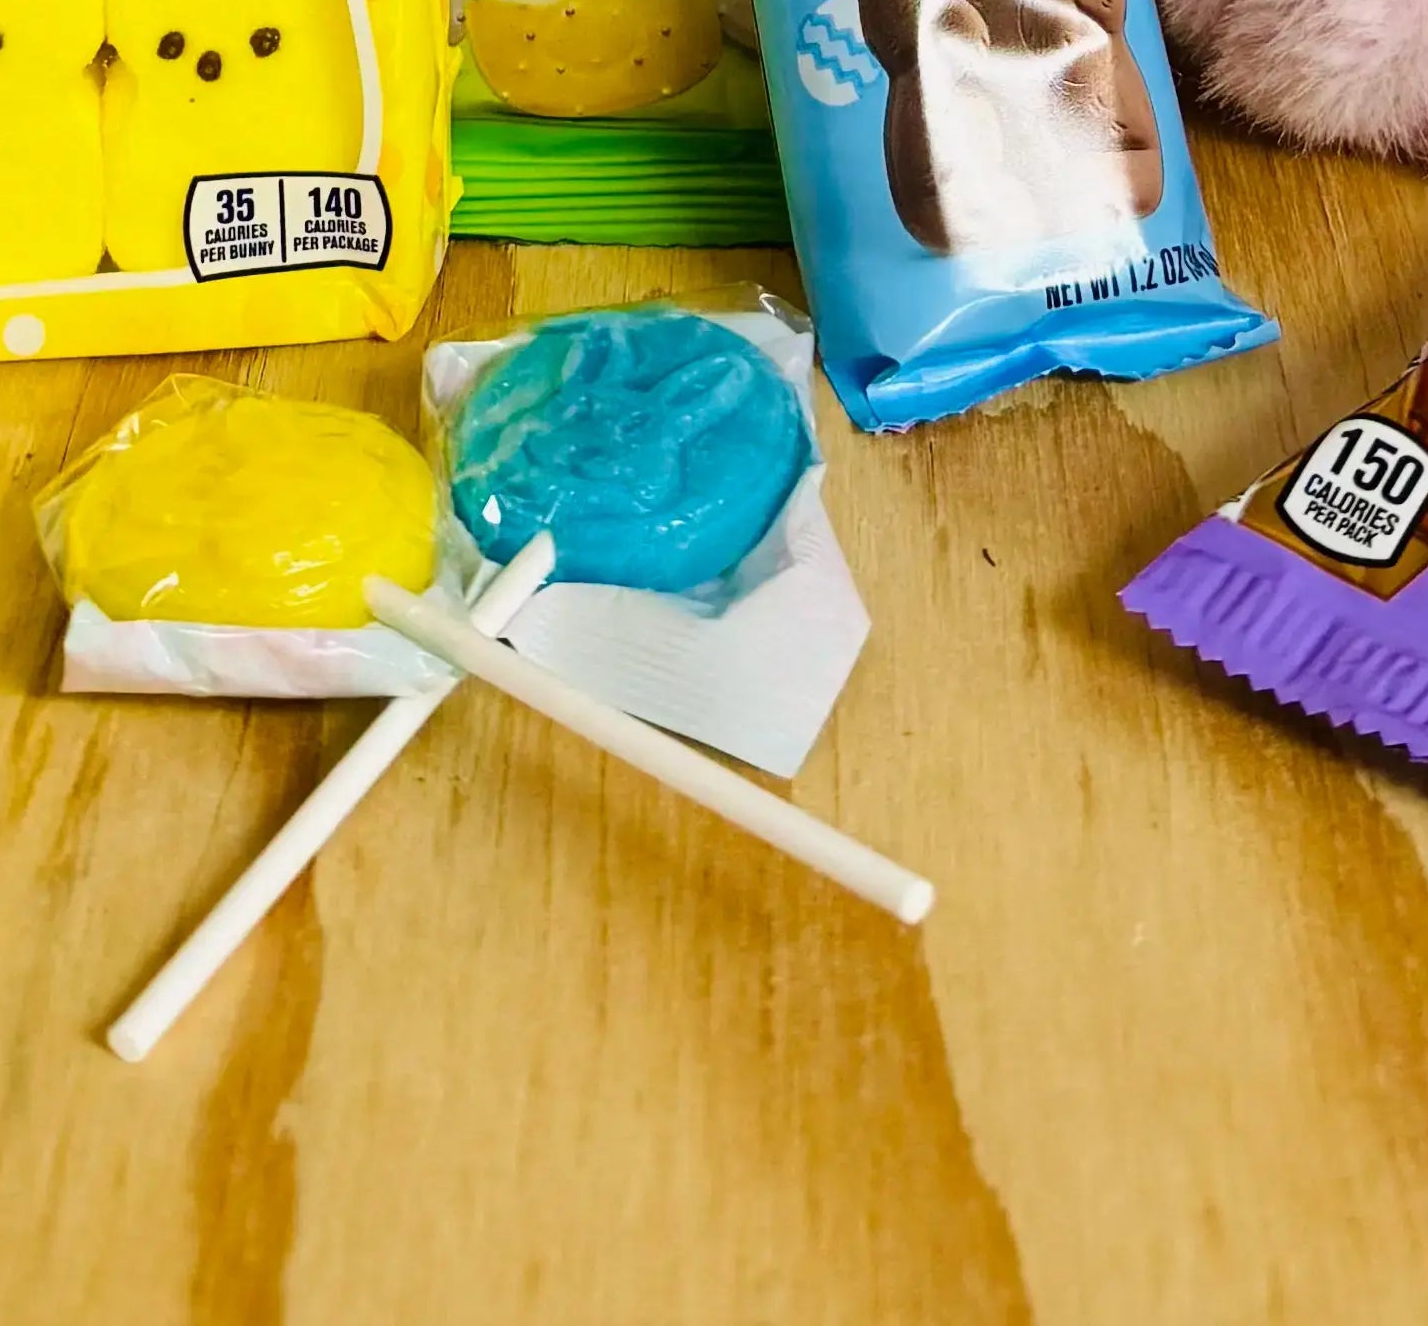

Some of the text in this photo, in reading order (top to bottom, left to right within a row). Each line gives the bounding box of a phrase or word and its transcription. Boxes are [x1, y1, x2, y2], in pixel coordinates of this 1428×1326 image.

[216, 188, 255, 224] 35
[308, 187, 362, 219] 140
[205, 224, 268, 245] CALORIES
[304, 219, 367, 235] CALORIES
[200, 240, 274, 264] PER BUNNY
[294, 235, 379, 254] PER PACKAGE
[1160, 245, 1189, 285] OZ
[1329, 427, 1424, 506] 150
[1304, 473, 1400, 537] CALORIES
[1303, 499, 1379, 549] PER PACK
